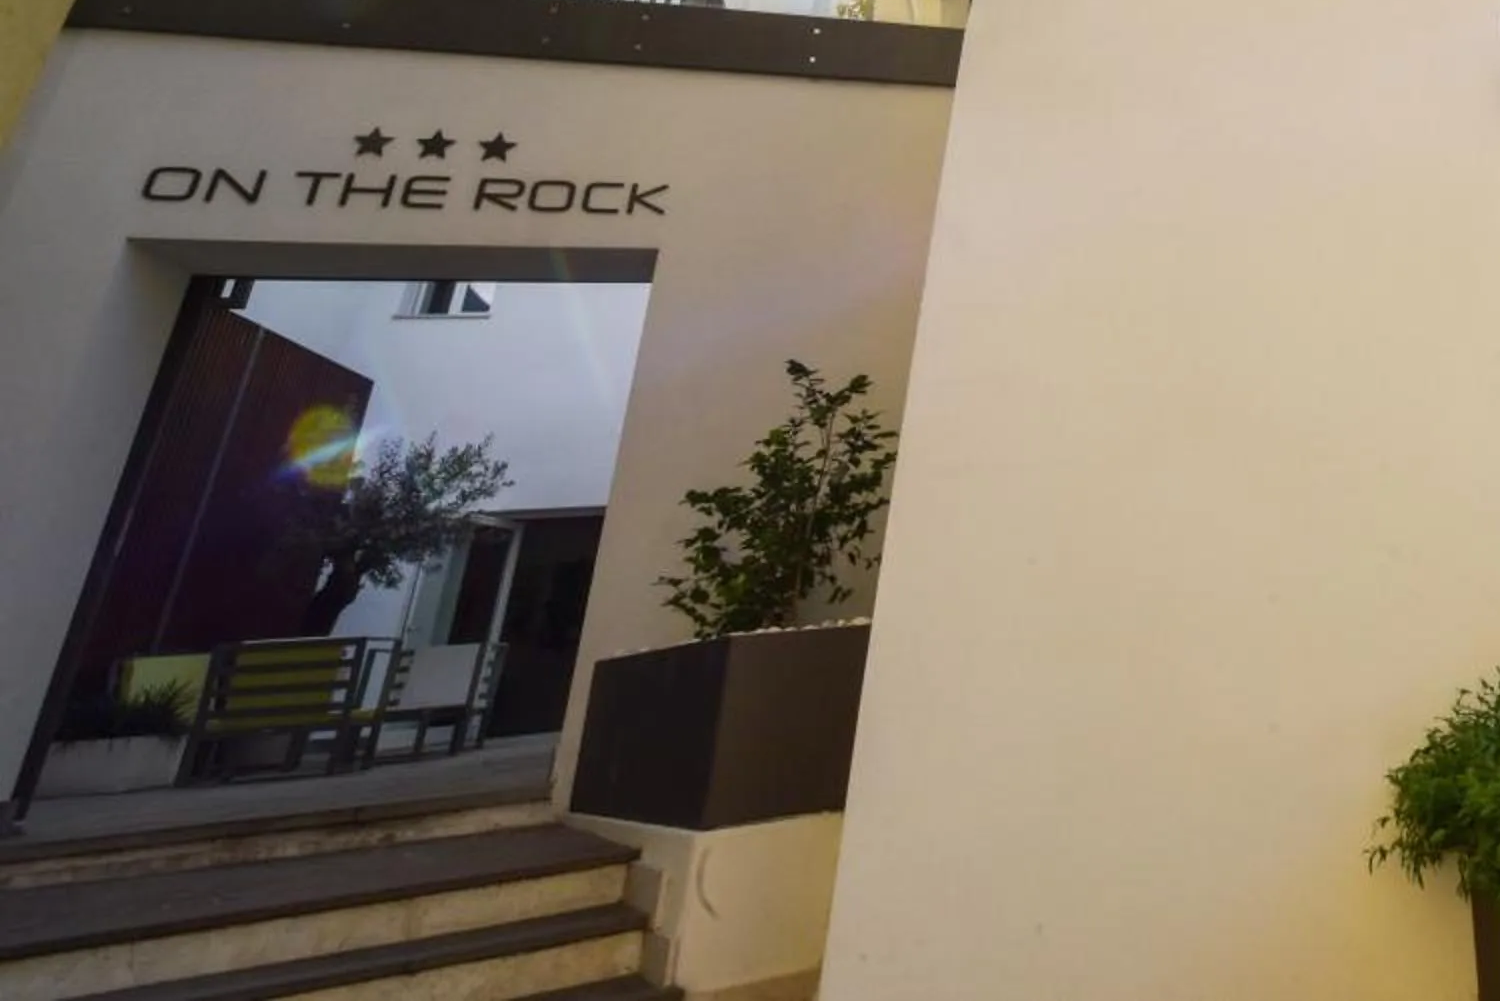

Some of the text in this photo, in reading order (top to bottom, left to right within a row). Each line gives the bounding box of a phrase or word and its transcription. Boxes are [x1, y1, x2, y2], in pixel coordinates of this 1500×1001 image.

[141, 166, 670, 216] ON THE ROCK
